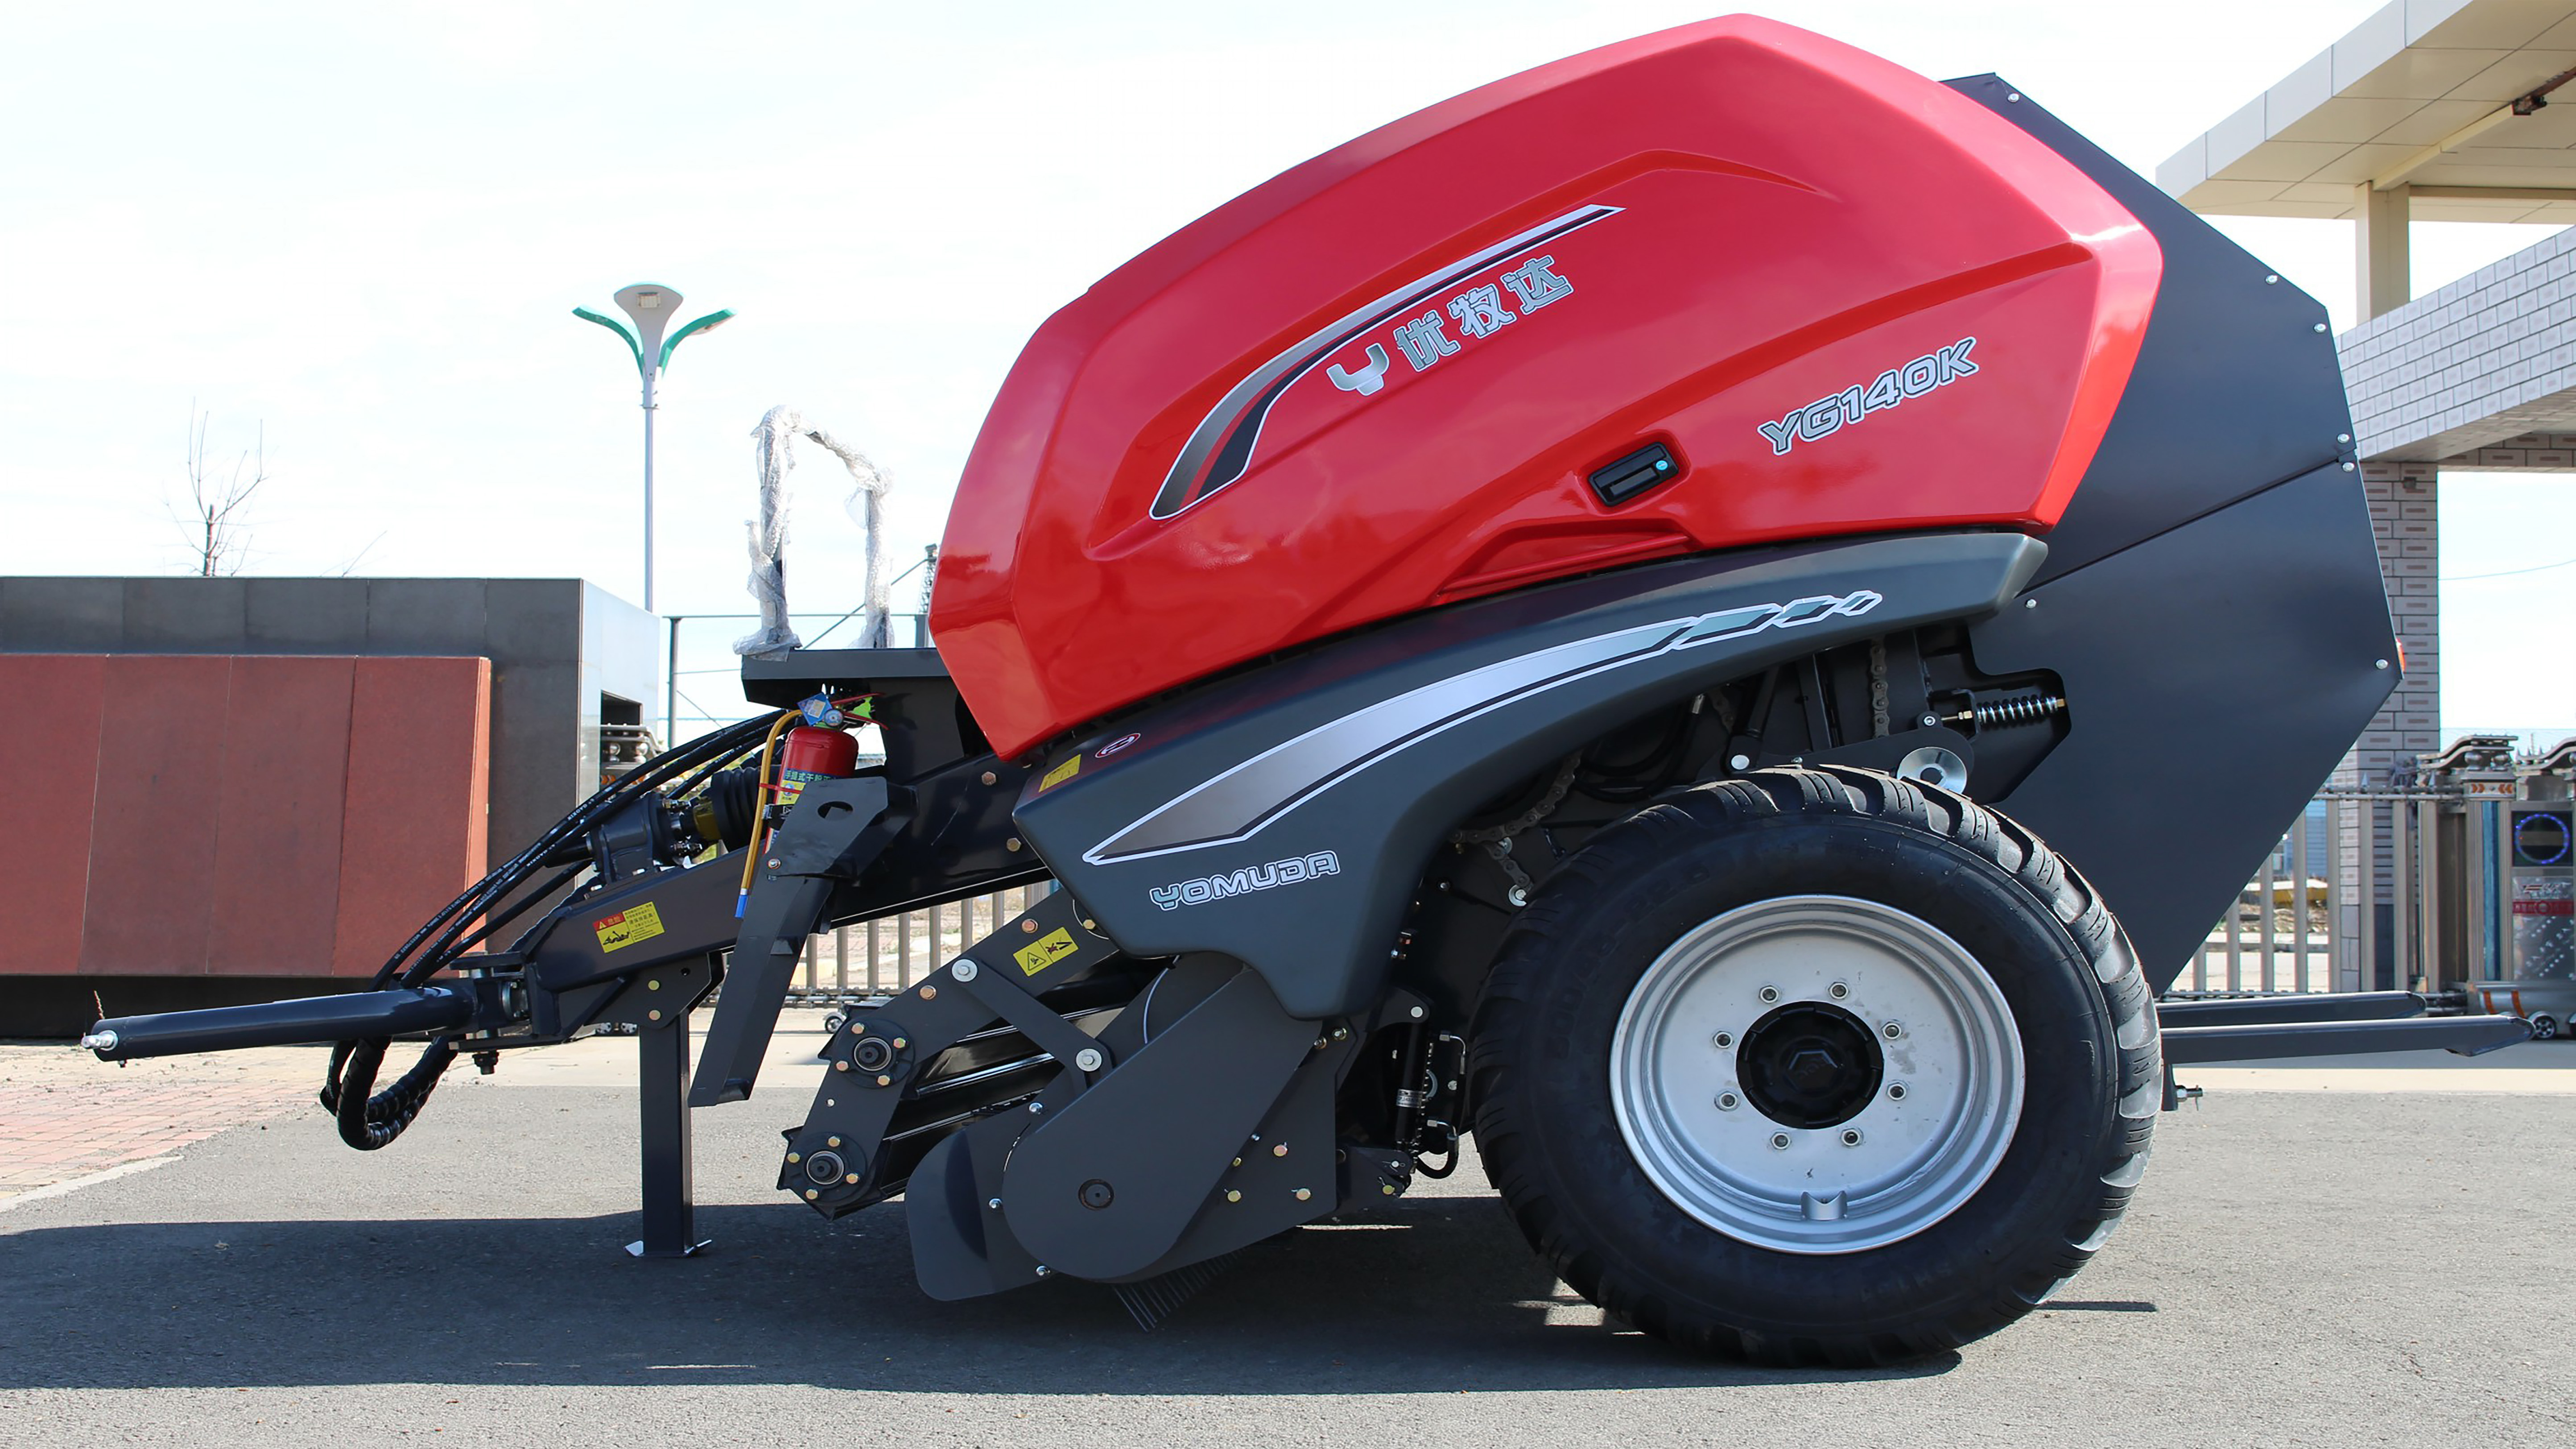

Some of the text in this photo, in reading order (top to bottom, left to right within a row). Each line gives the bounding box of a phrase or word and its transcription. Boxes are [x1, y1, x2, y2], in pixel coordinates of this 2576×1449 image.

[1393, 255, 1574, 372] 优牧达
[1758, 336, 1979, 455] YG140K
[784, 769, 837, 782] 手提式干粉
[1149, 850, 1341, 911] YOMUDA
